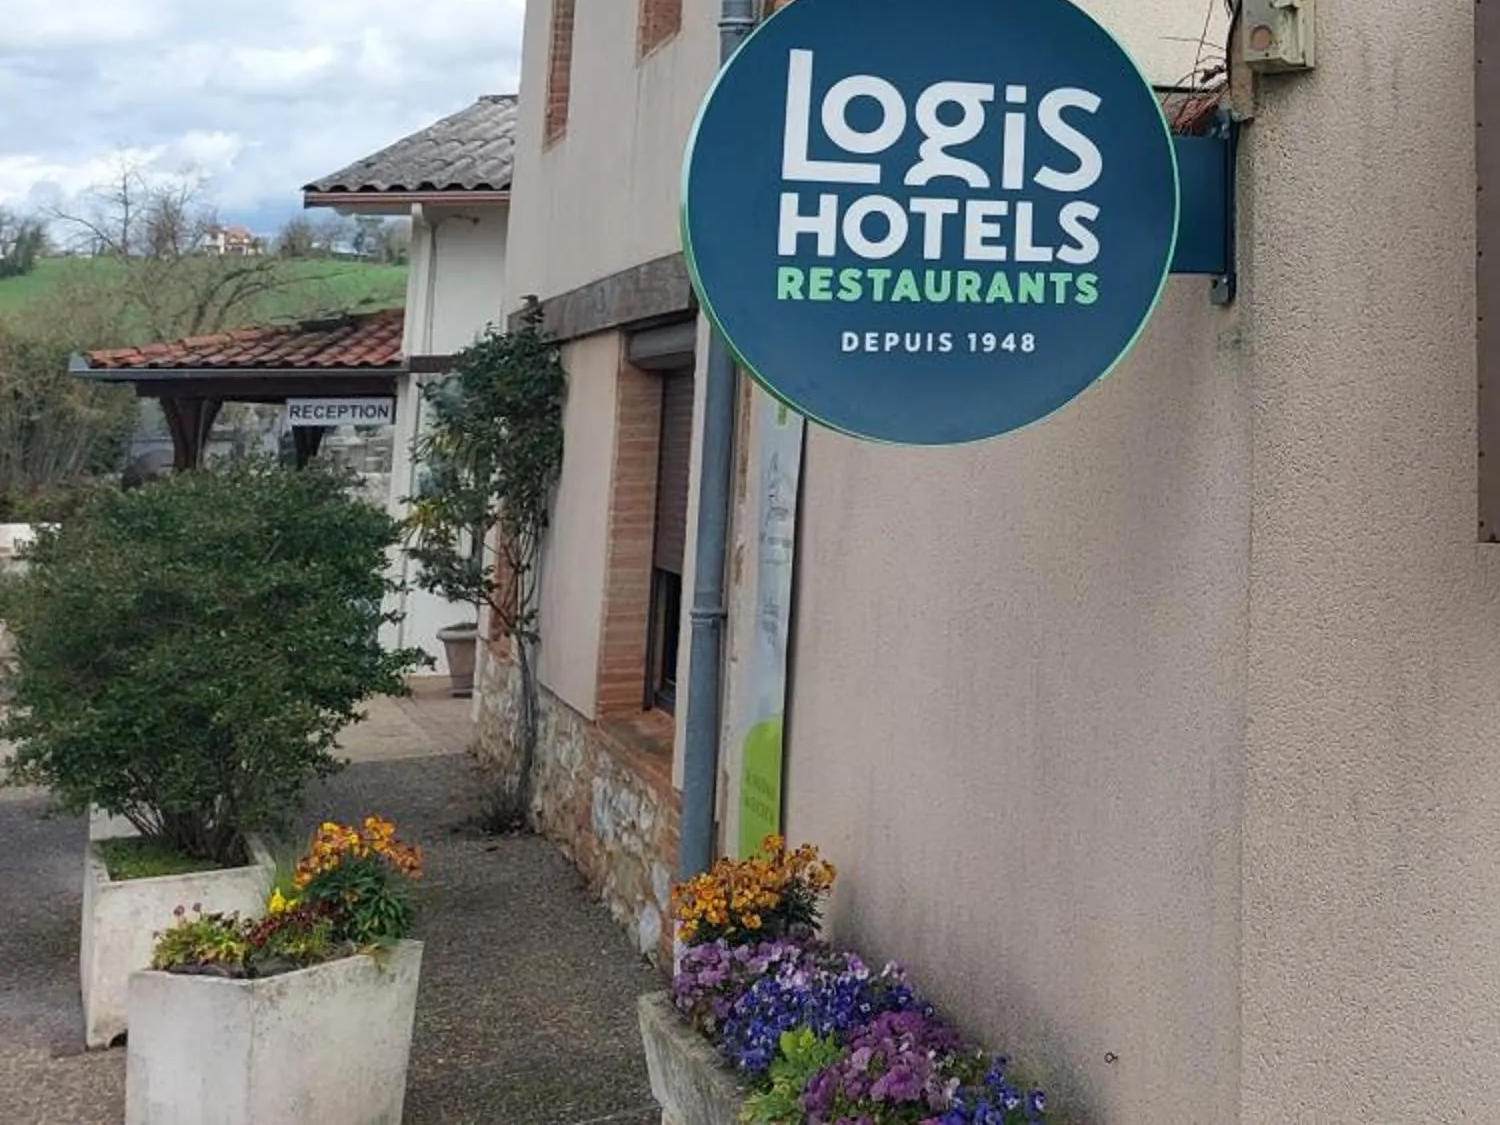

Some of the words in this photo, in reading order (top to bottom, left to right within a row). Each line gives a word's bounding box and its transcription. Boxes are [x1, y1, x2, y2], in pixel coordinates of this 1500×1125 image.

[777, 191, 1102, 264] HOTELS
[776, 266, 1100, 304] RESTAURANTS
[841, 331, 954, 353] DEPUIS
[967, 331, 1037, 353] 1948
[289, 404, 390, 420] RECEPTION
